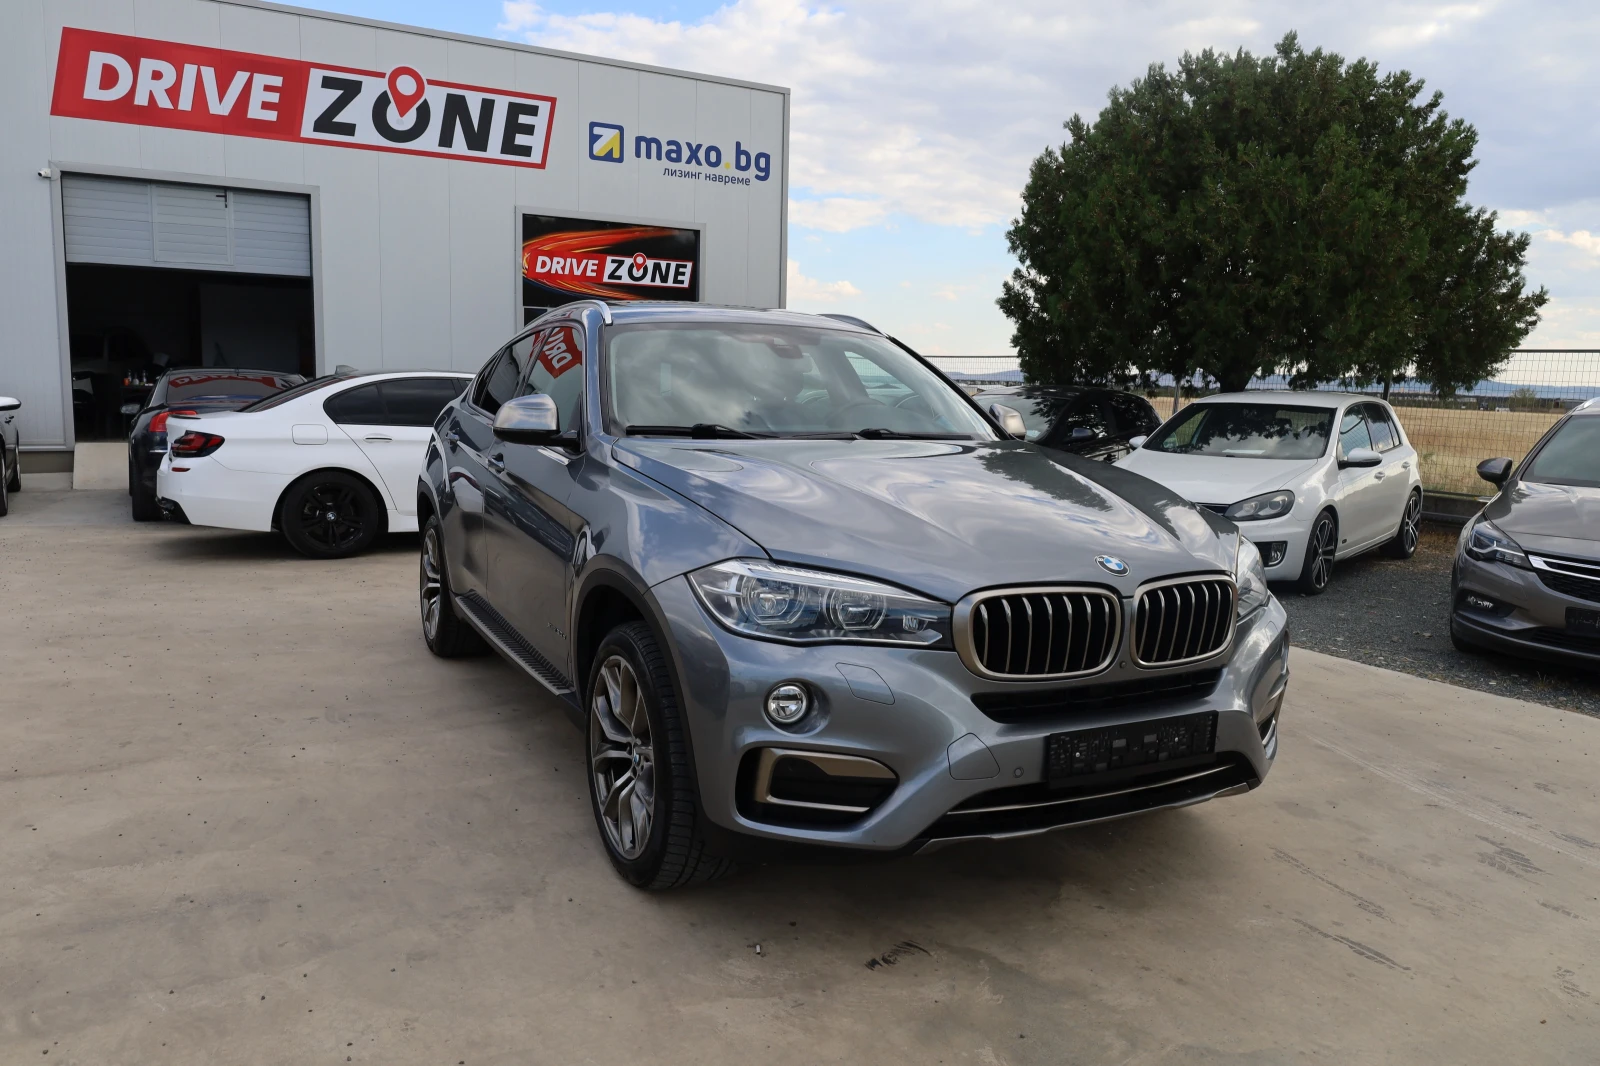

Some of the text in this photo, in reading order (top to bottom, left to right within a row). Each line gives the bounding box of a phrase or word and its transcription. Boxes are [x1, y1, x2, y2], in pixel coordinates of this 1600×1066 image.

[83, 50, 541, 158] DRIVE ZONE
[635, 135, 771, 182] maxo.bg
[662, 167, 751, 186] лизинг навреме
[535, 255, 688, 285] DRIVE ZONE
